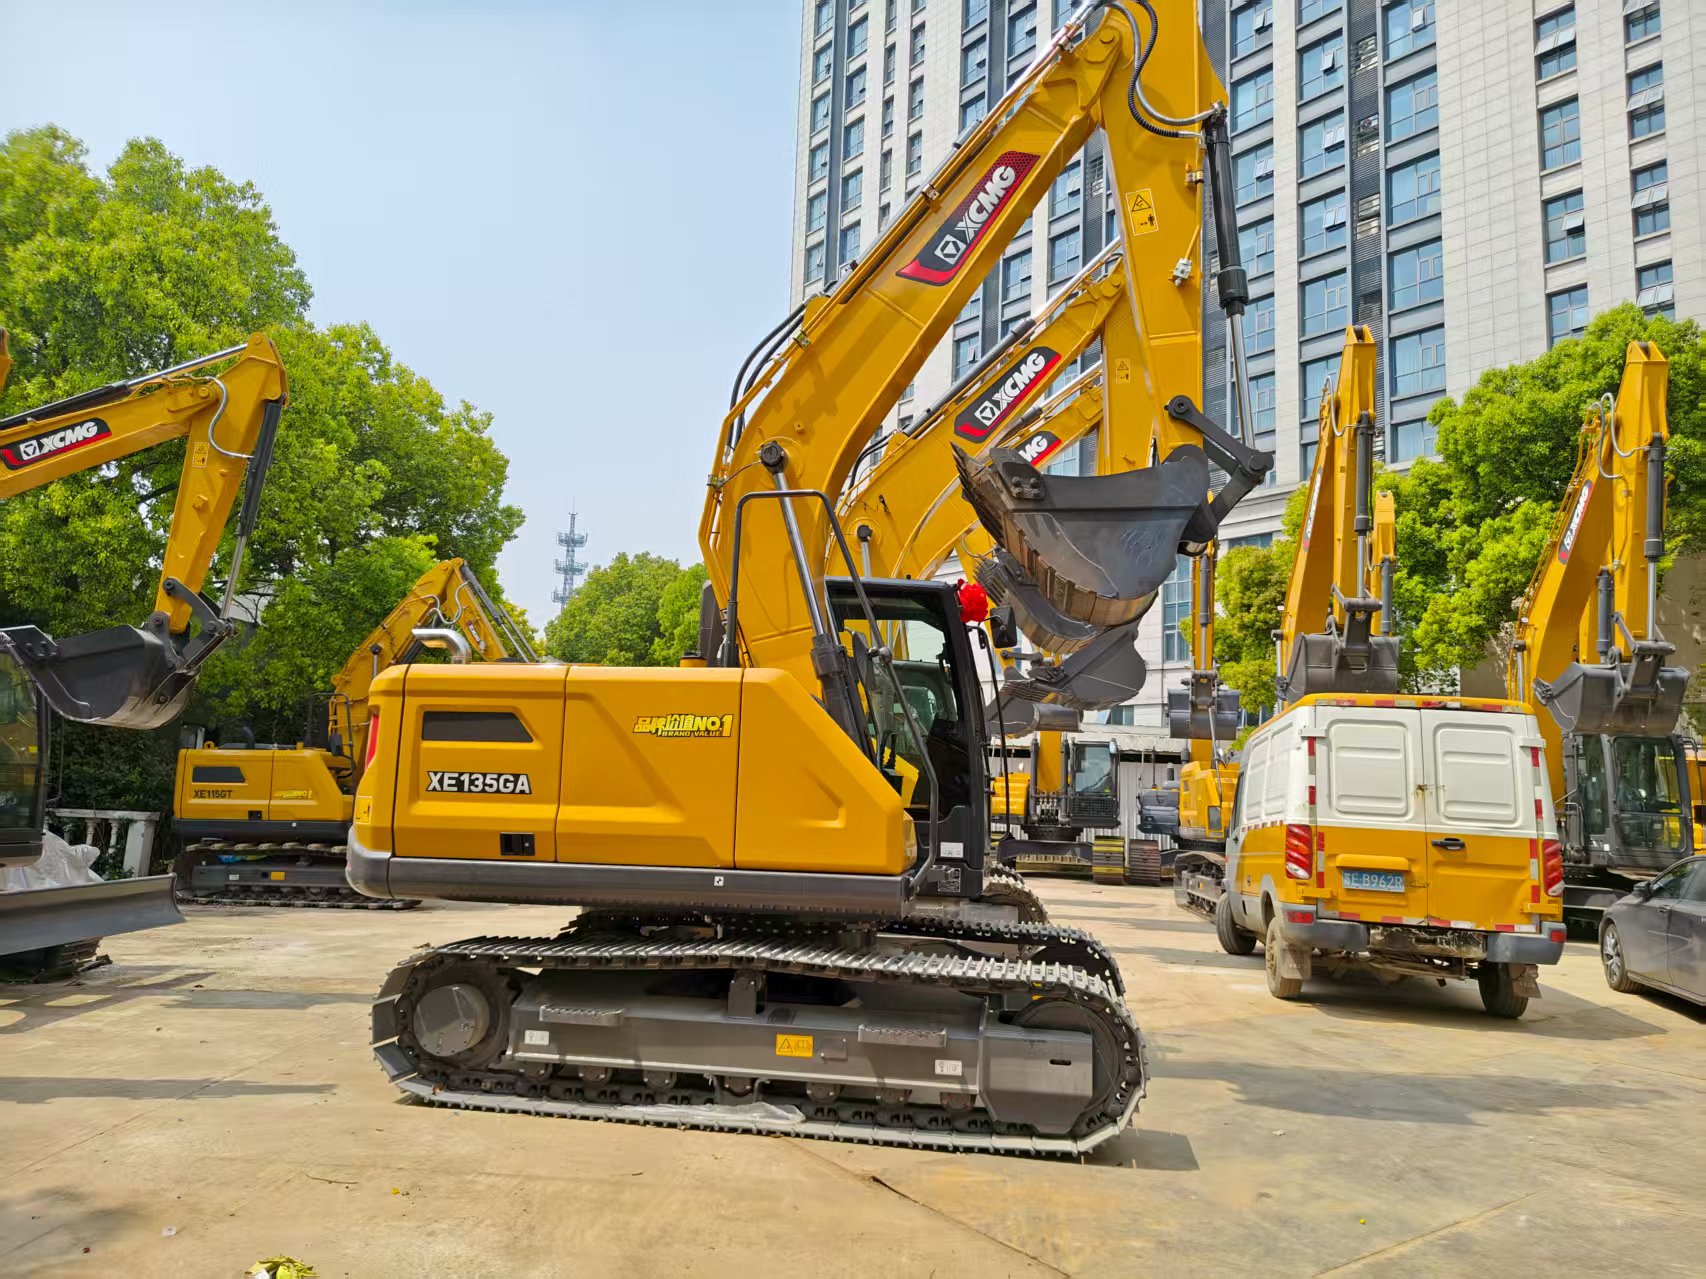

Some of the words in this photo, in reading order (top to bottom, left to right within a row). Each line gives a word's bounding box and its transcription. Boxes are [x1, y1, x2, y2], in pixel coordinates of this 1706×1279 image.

[955, 166, 1016, 244] XCMG
[992, 353, 1045, 412] XCMG
[40, 422, 98, 454] XCMG
[1018, 436, 1048, 463] MG
[193, 790, 233, 799] XE115GT
[427, 772, 530, 794] XE135GA
